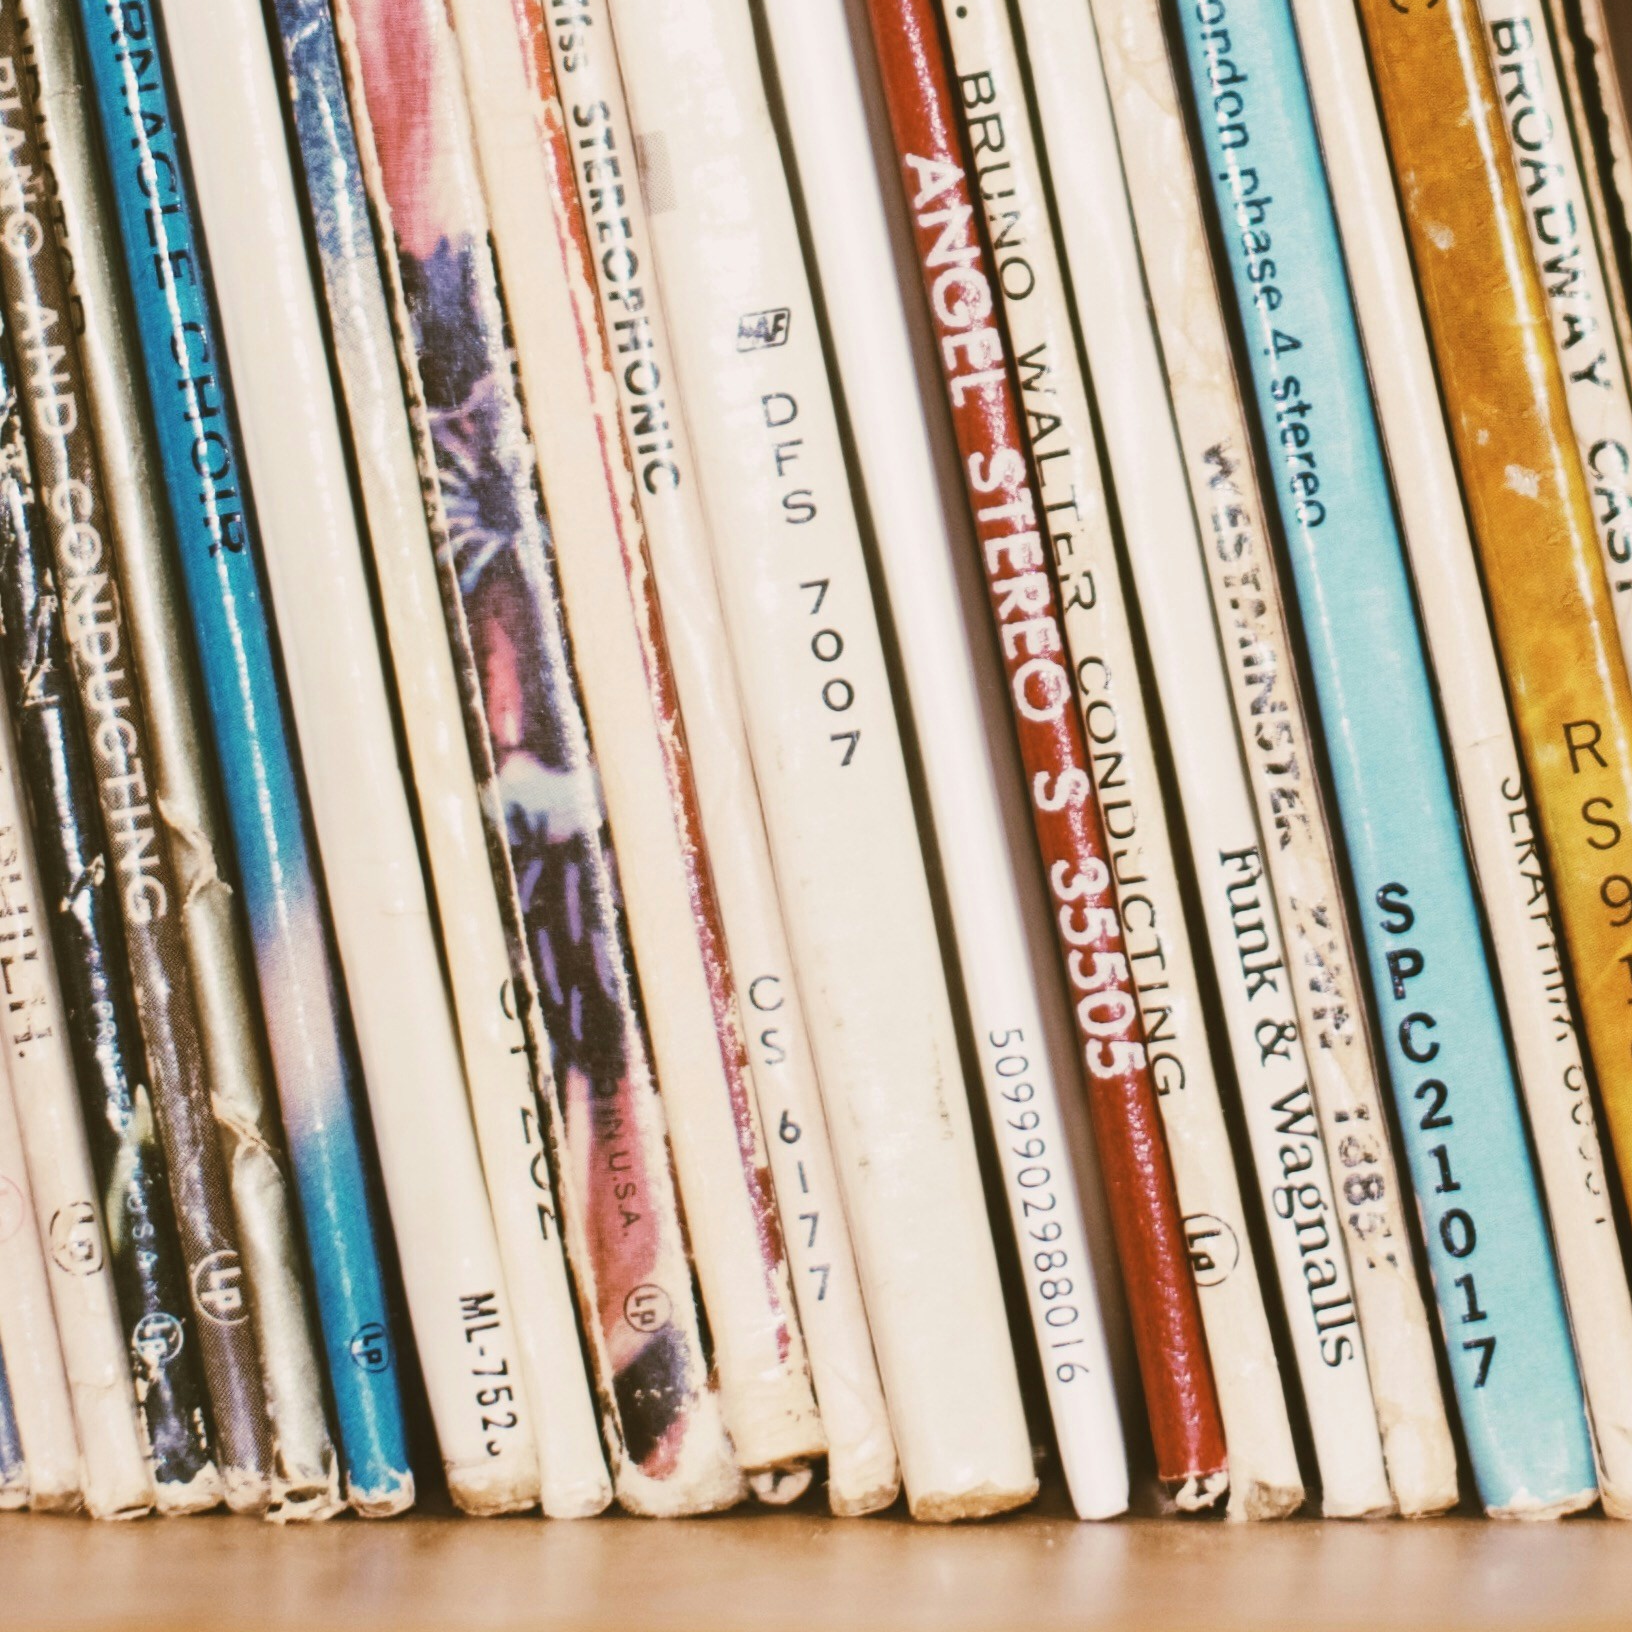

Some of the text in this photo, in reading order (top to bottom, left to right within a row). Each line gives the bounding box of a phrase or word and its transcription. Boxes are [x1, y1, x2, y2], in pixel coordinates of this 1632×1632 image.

[572, 100, 681, 497] STEREOPHONIC
[1221, 167, 1284, 312] phase
[1263, 328, 1302, 357] 4
[1490, 17, 1611, 390] BROADWAY
[171, 321, 247, 558] CHOIR
[958, 70, 1036, 302] BRUNO
[1017, 341, 1096, 615] WALTER
[1077, 655, 1187, 1098] CONDUCTING
[1270, 375, 1328, 530] stereo
[15, 298, 77, 437] AND
[51, 477, 168, 925] CONDUCTING
[800, 578, 861, 767] 7007
[905, 149, 1147, 1081] ANGEL STEREO S 35505
[607, 1150, 641, 1238] U.S.A.
[777, 1108, 831, 1302] 6177
[988, 1027, 1090, 1385] 5099902988016
[1219, 844, 1355, 1368] Funk & Wagnalls
